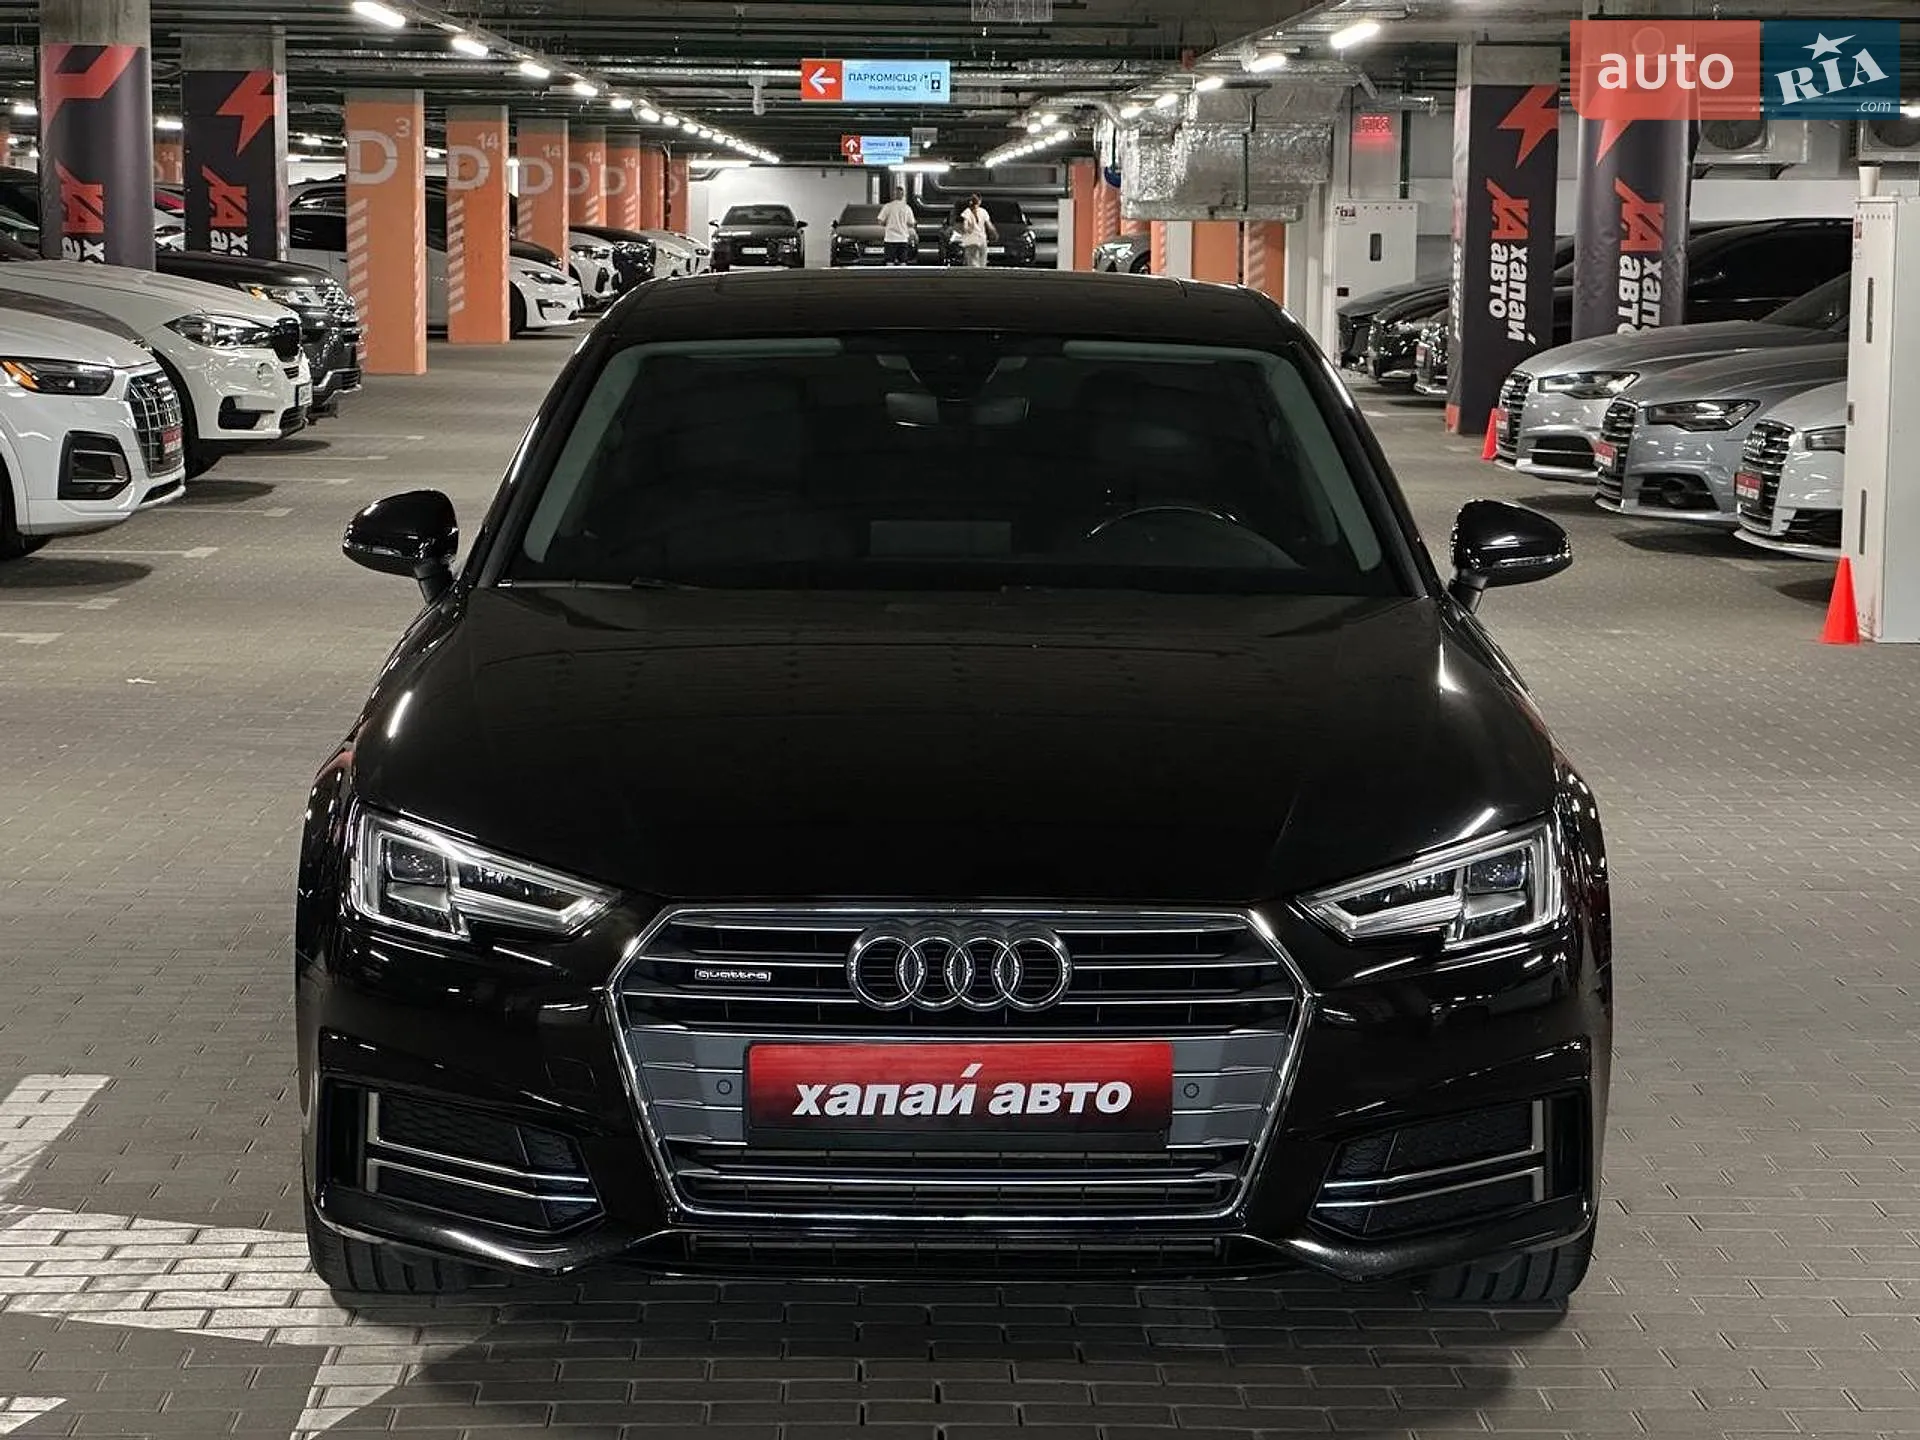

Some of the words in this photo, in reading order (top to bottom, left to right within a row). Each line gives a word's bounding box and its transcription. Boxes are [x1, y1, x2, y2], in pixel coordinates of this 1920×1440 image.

[848, 73, 918, 82] ПАРКОМІСЦЯ
[347, 130, 397, 185] D
[395, 117, 411, 138] 3
[448, 145, 490, 190] D
[477, 132, 499, 150] 14
[518, 157, 553, 195] D
[1489, 242, 1508, 318] авто
[1640, 257, 1663, 333] хап
[696, 969, 771, 981] quattro
[792, 1063, 983, 1116] хапай
[988, 1081, 1132, 1114] авто
